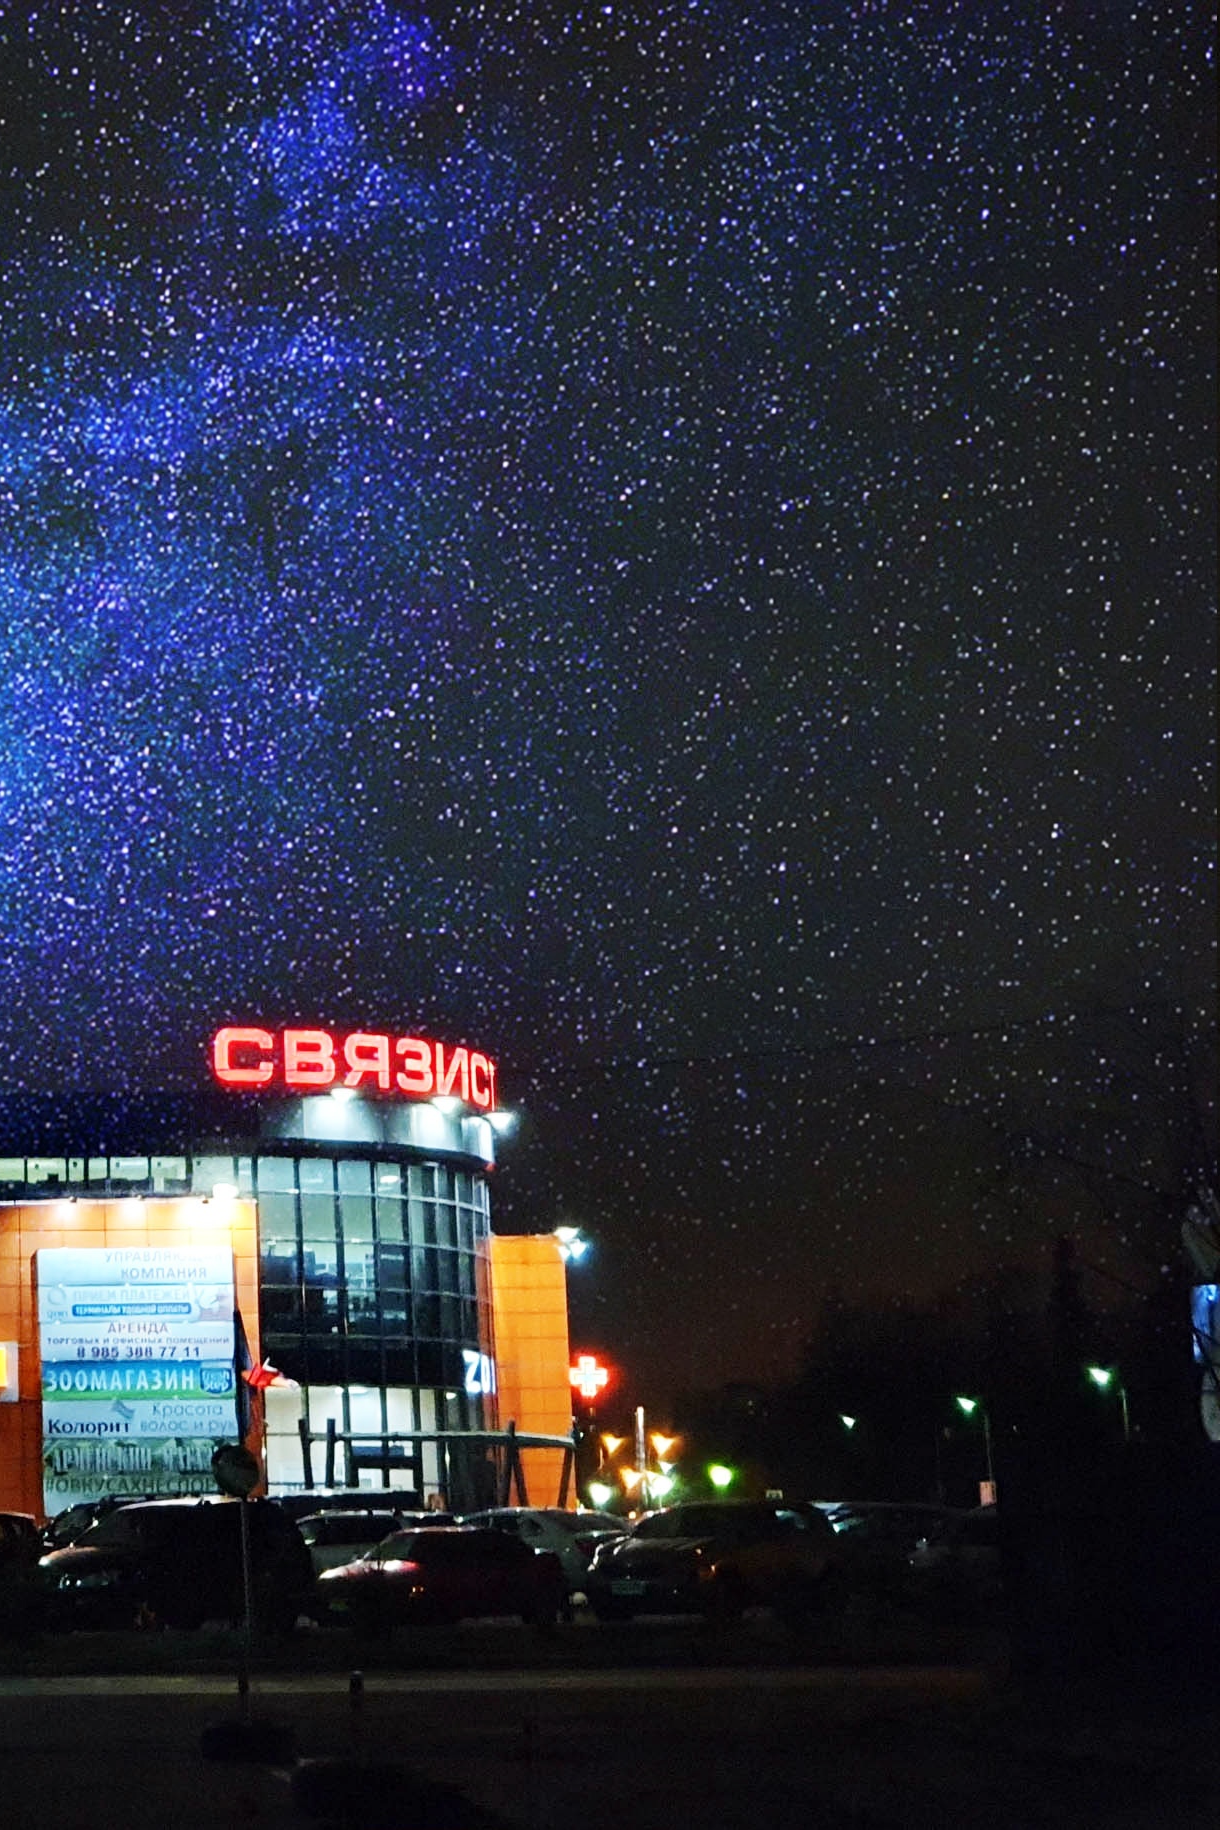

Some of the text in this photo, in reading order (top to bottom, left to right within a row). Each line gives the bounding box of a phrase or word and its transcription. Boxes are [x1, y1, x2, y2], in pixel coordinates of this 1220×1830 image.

[104, 1250, 223, 1264] УПРАВЛЯ
[121, 1267, 208, 1280] КОМПАНИЯ
[107, 1321, 169, 1334] АРЕНДА
[47, 1337, 99, 1345] ТОРГОВЫХ
[77, 1346, 86, 1358] 8
[159, 1346, 177, 1358] 77
[183, 1345, 200, 1357] 11
[46, 1367, 195, 1392] ЗООМАГАЗИН
[152, 1402, 223, 1417] Красота
[47, 1418, 130, 1435] Колорит
[140, 1419, 188, 1432] волос
[193, 1420, 204, 1431] и
